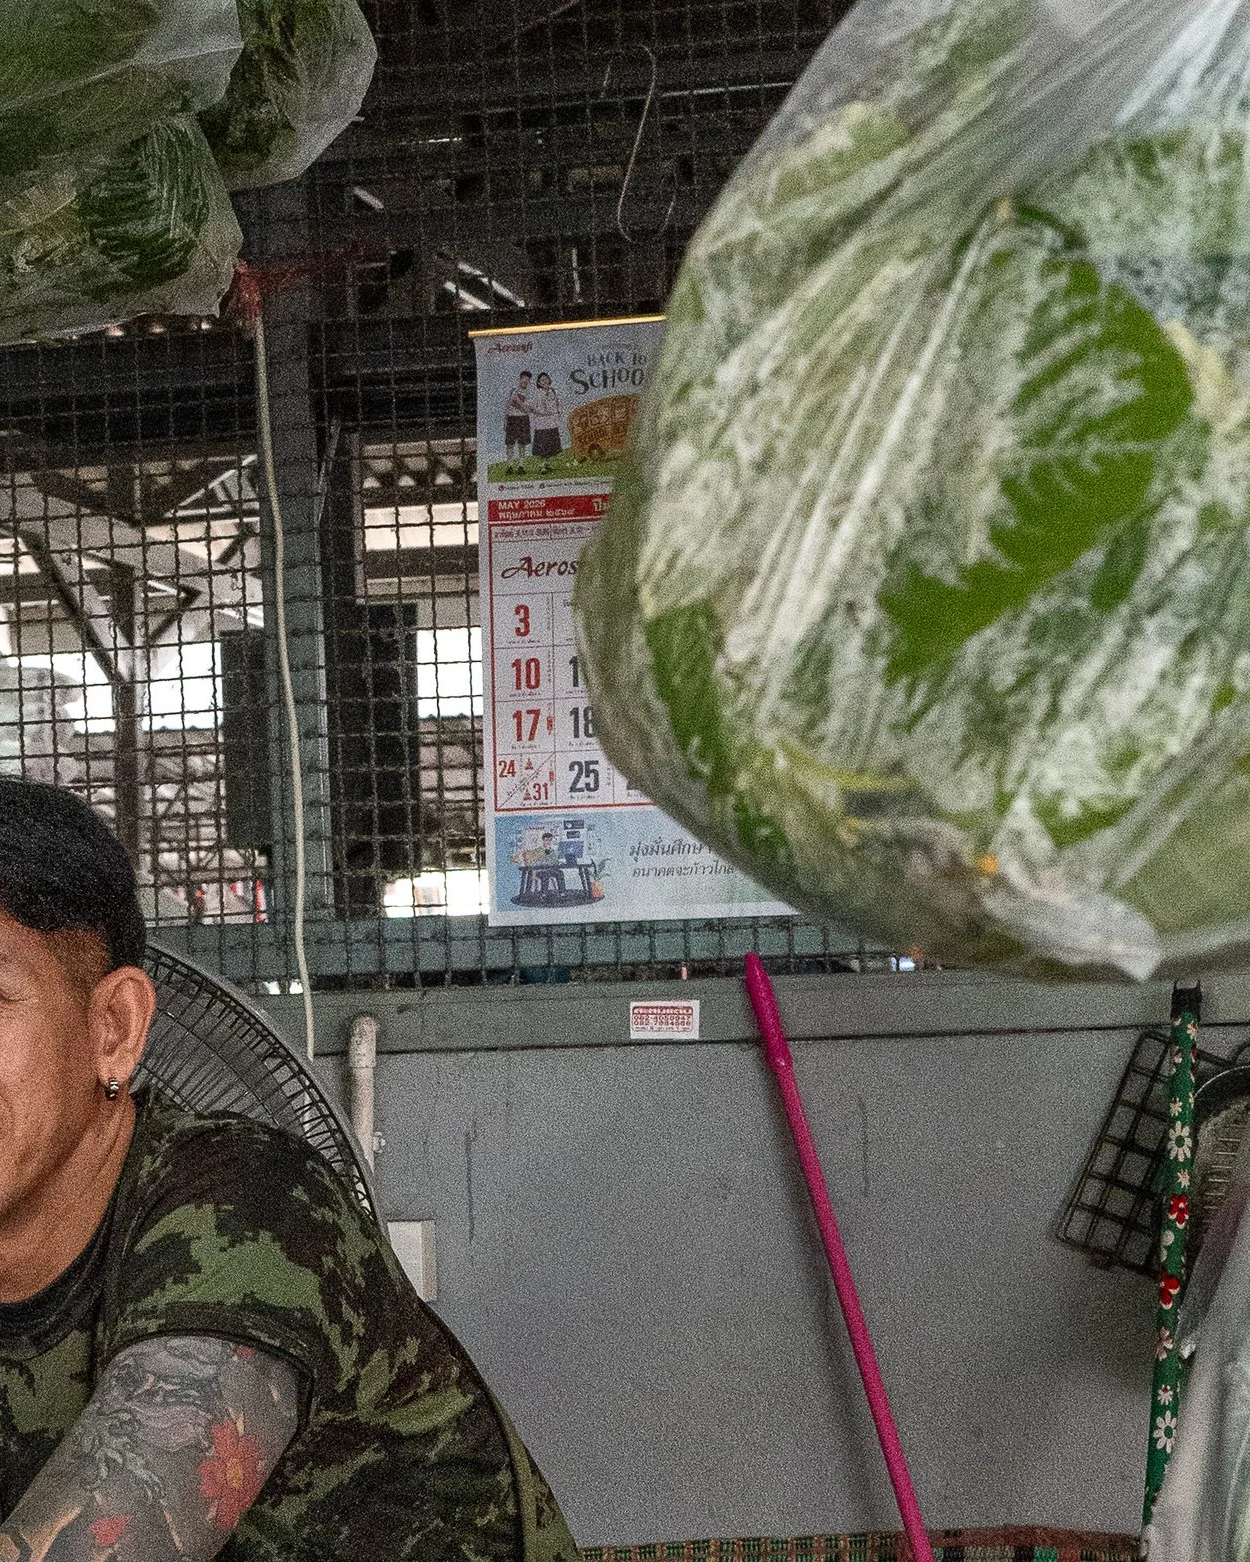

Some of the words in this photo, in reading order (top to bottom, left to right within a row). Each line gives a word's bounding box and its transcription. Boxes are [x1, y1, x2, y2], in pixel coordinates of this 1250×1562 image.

[587, 351, 625, 367] BACK
[570, 368, 645, 395] SCHOO
[498, 501, 520, 510] MAY
[523, 499, 546, 509] 2026
[501, 556, 579, 579] Aeros
[514, 604, 530, 637] 3
[511, 657, 541, 690] 10
[569, 656, 580, 688] 1
[512, 709, 541, 742] 17
[569, 706, 596, 739] 18
[498, 760, 516, 778] 24
[568, 760, 600, 793] 25
[533, 783, 549, 801] 31
